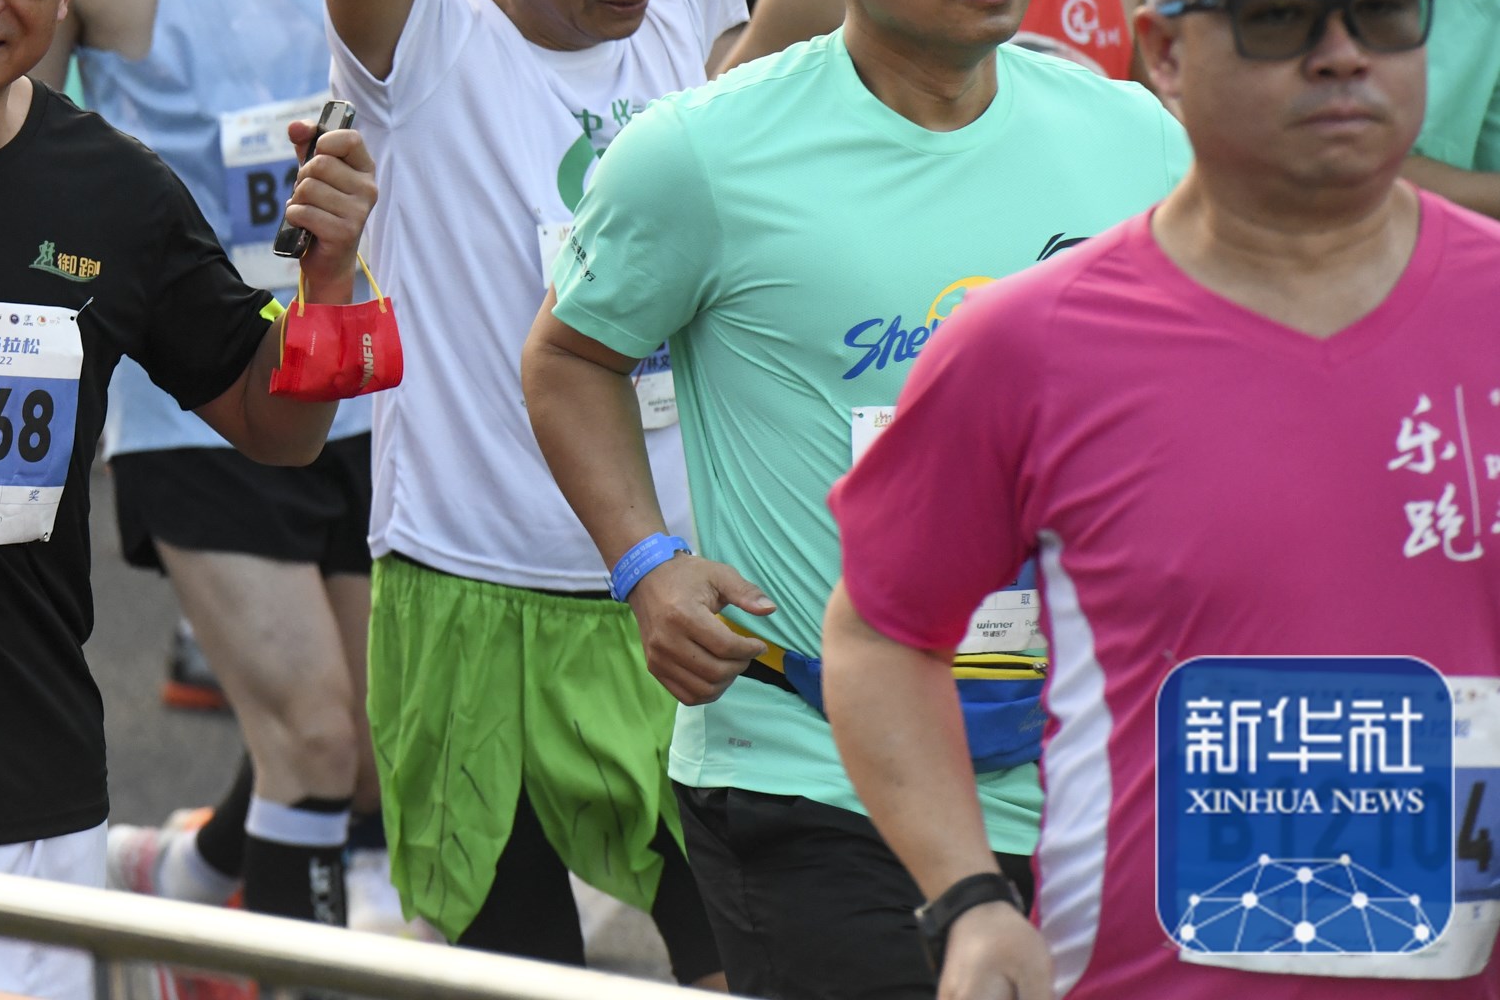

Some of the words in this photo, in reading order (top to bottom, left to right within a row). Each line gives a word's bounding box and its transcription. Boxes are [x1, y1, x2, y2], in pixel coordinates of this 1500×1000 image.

[28, 489, 41, 502] 奖
[1021, 593, 1030, 605] 取
[977, 620, 1014, 629] winner
